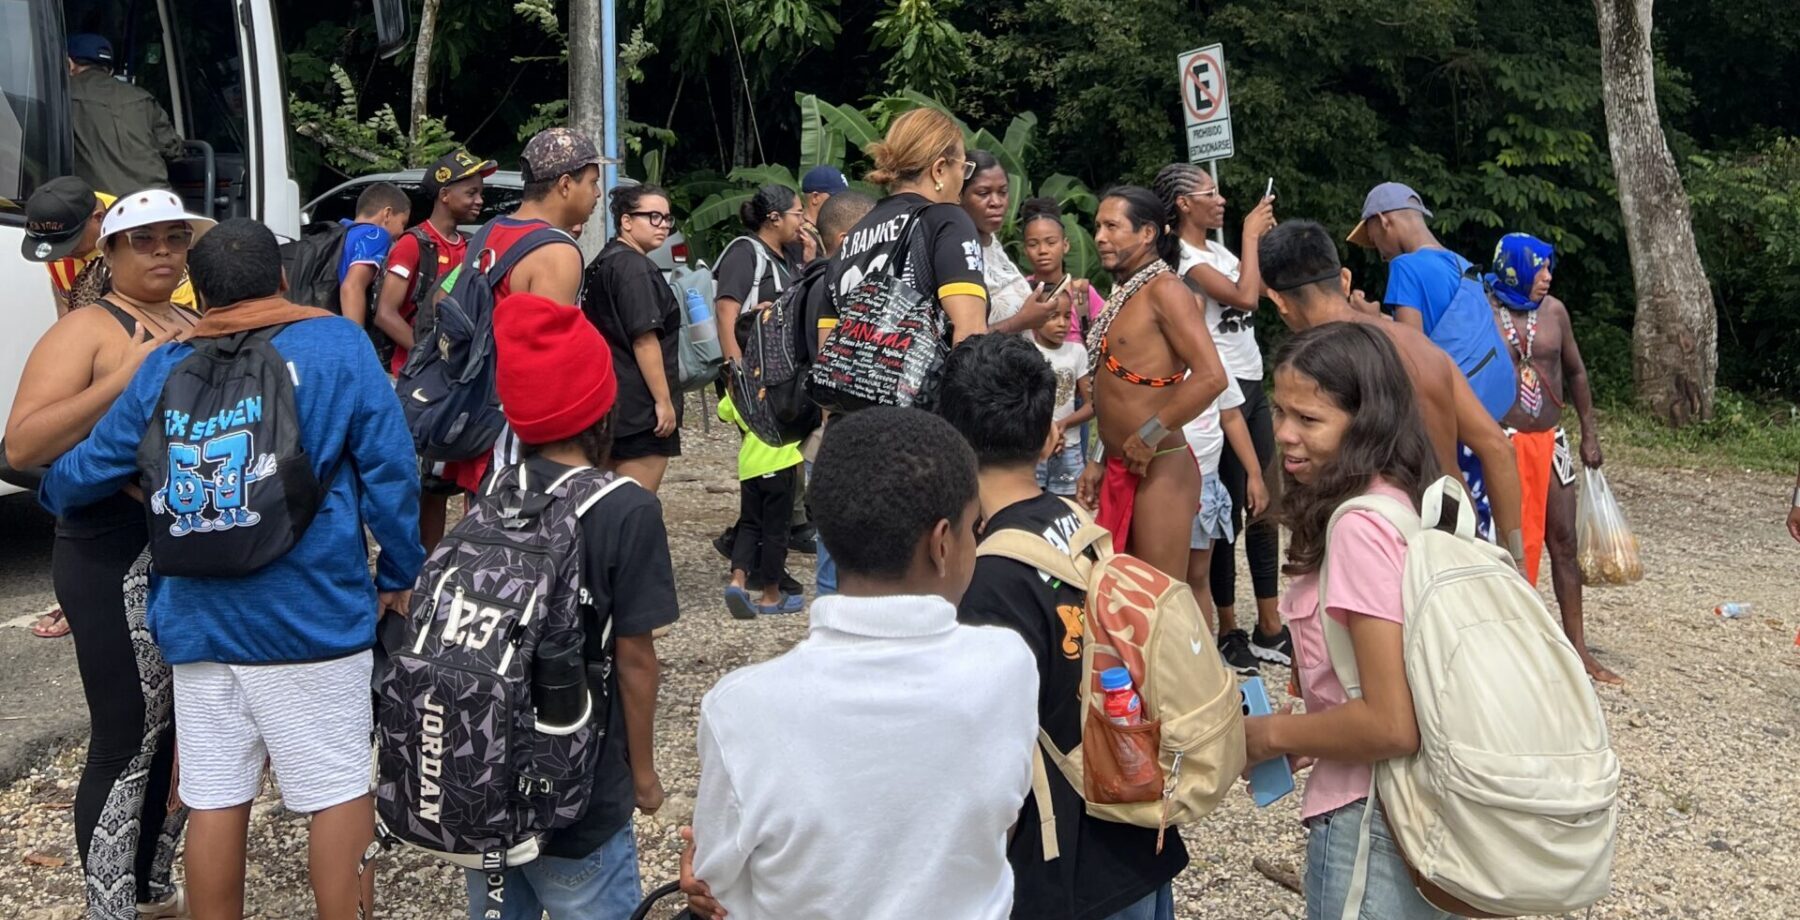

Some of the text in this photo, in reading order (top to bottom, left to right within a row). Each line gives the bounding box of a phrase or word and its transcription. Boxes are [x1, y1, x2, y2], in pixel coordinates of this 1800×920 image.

[1192, 125, 1222, 140] PROHIBIDO
[839, 319, 914, 350] PANAMA
[189, 396, 262, 441] SEVEN
[419, 693, 444, 824] JORDAN
